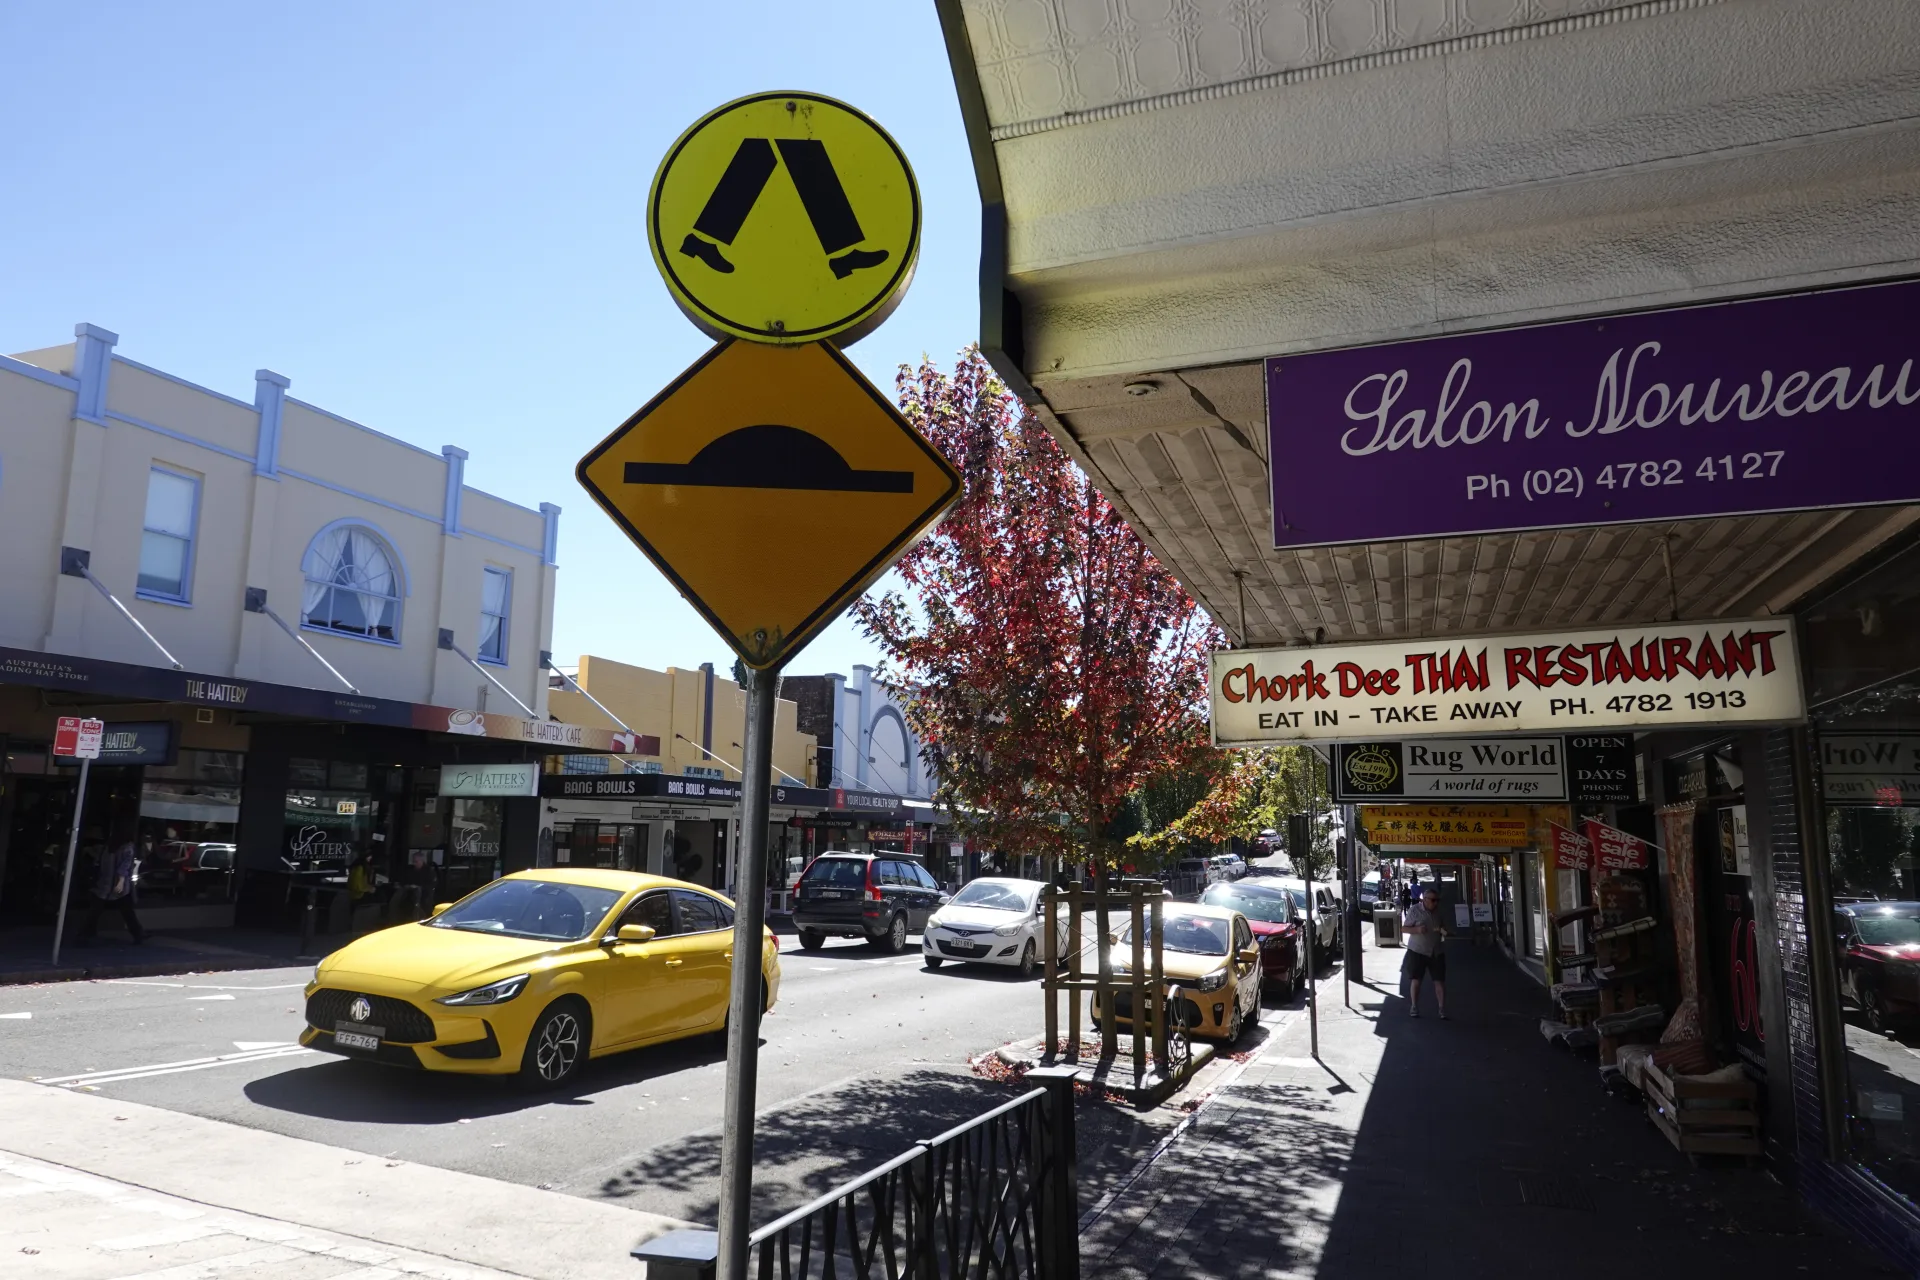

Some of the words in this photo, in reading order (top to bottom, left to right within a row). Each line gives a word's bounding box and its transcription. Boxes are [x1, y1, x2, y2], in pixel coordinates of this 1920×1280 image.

[1341, 358, 1550, 457] Salon
[1565, 341, 1920, 438] Nouveau
[1467, 473, 1510, 500] Ph
[1523, 467, 1584, 501] (02)
[1596, 459, 1684, 490] 4782
[1696, 450, 1785, 482] 4127
[0, 665, 32, 674] ADING
[36, 669, 55, 677] HAT
[59, 672, 89, 681] STORE
[1221, 659, 1330, 704] Chork
[1331, 661, 1400, 698] Dee
[1405, 646, 1490, 697] THAI
[1504, 630, 1786, 690] RESTAURANT
[186, 679, 205, 698] THE
[207, 683, 248, 703] HATTERY
[1258, 712, 1304, 730] EAT
[1315, 710, 1339, 727] IN
[1370, 704, 1438, 725] TAKE
[1450, 700, 1523, 720] AWAY
[1550, 697, 1595, 716] PH.
[1605, 693, 1673, 714] 4782
[1685, 690, 1747, 711] 1913
[522, 721, 534, 738] THE
[537, 724, 563, 741] HATTERS
[105, 732, 137, 748] HATTERY
[1573, 737, 1626, 748] OPEN
[1360, 744, 1390, 757] RUG
[1408, 744, 1464, 772] Rug
[1471, 744, 1557, 768] World
[1596, 755, 1605, 764] 7
[475, 772, 526, 786] HATTER'S
[1577, 769, 1627, 780] DAYS
[564, 781, 592, 794] BANG
[596, 781, 635, 793] BOWLS
[668, 781, 684, 793] BANG
[686, 783, 705, 795] BOWLS
[1350, 776, 1388, 792] WORLD
[1429, 779, 1441, 790] A
[1445, 779, 1484, 790] world
[1487, 778, 1504, 794] of
[1507, 780, 1539, 795] rugs
[847, 794, 859, 805] YOUR
[872, 797, 887, 808] HEALTH
[888, 798, 898, 809] SHOP
[1368, 831, 1404, 842] THREE
[1405, 832, 1447, 843] SISTERS
[1559, 831, 1588, 847] sale
[1599, 828, 1638, 846] sale
[293, 842, 352, 857] HATTER'S
[1559, 843, 1588, 859] sale
[1600, 842, 1639, 859] sale
[1559, 855, 1588, 870] sale
[1602, 856, 1640, 869] sale
